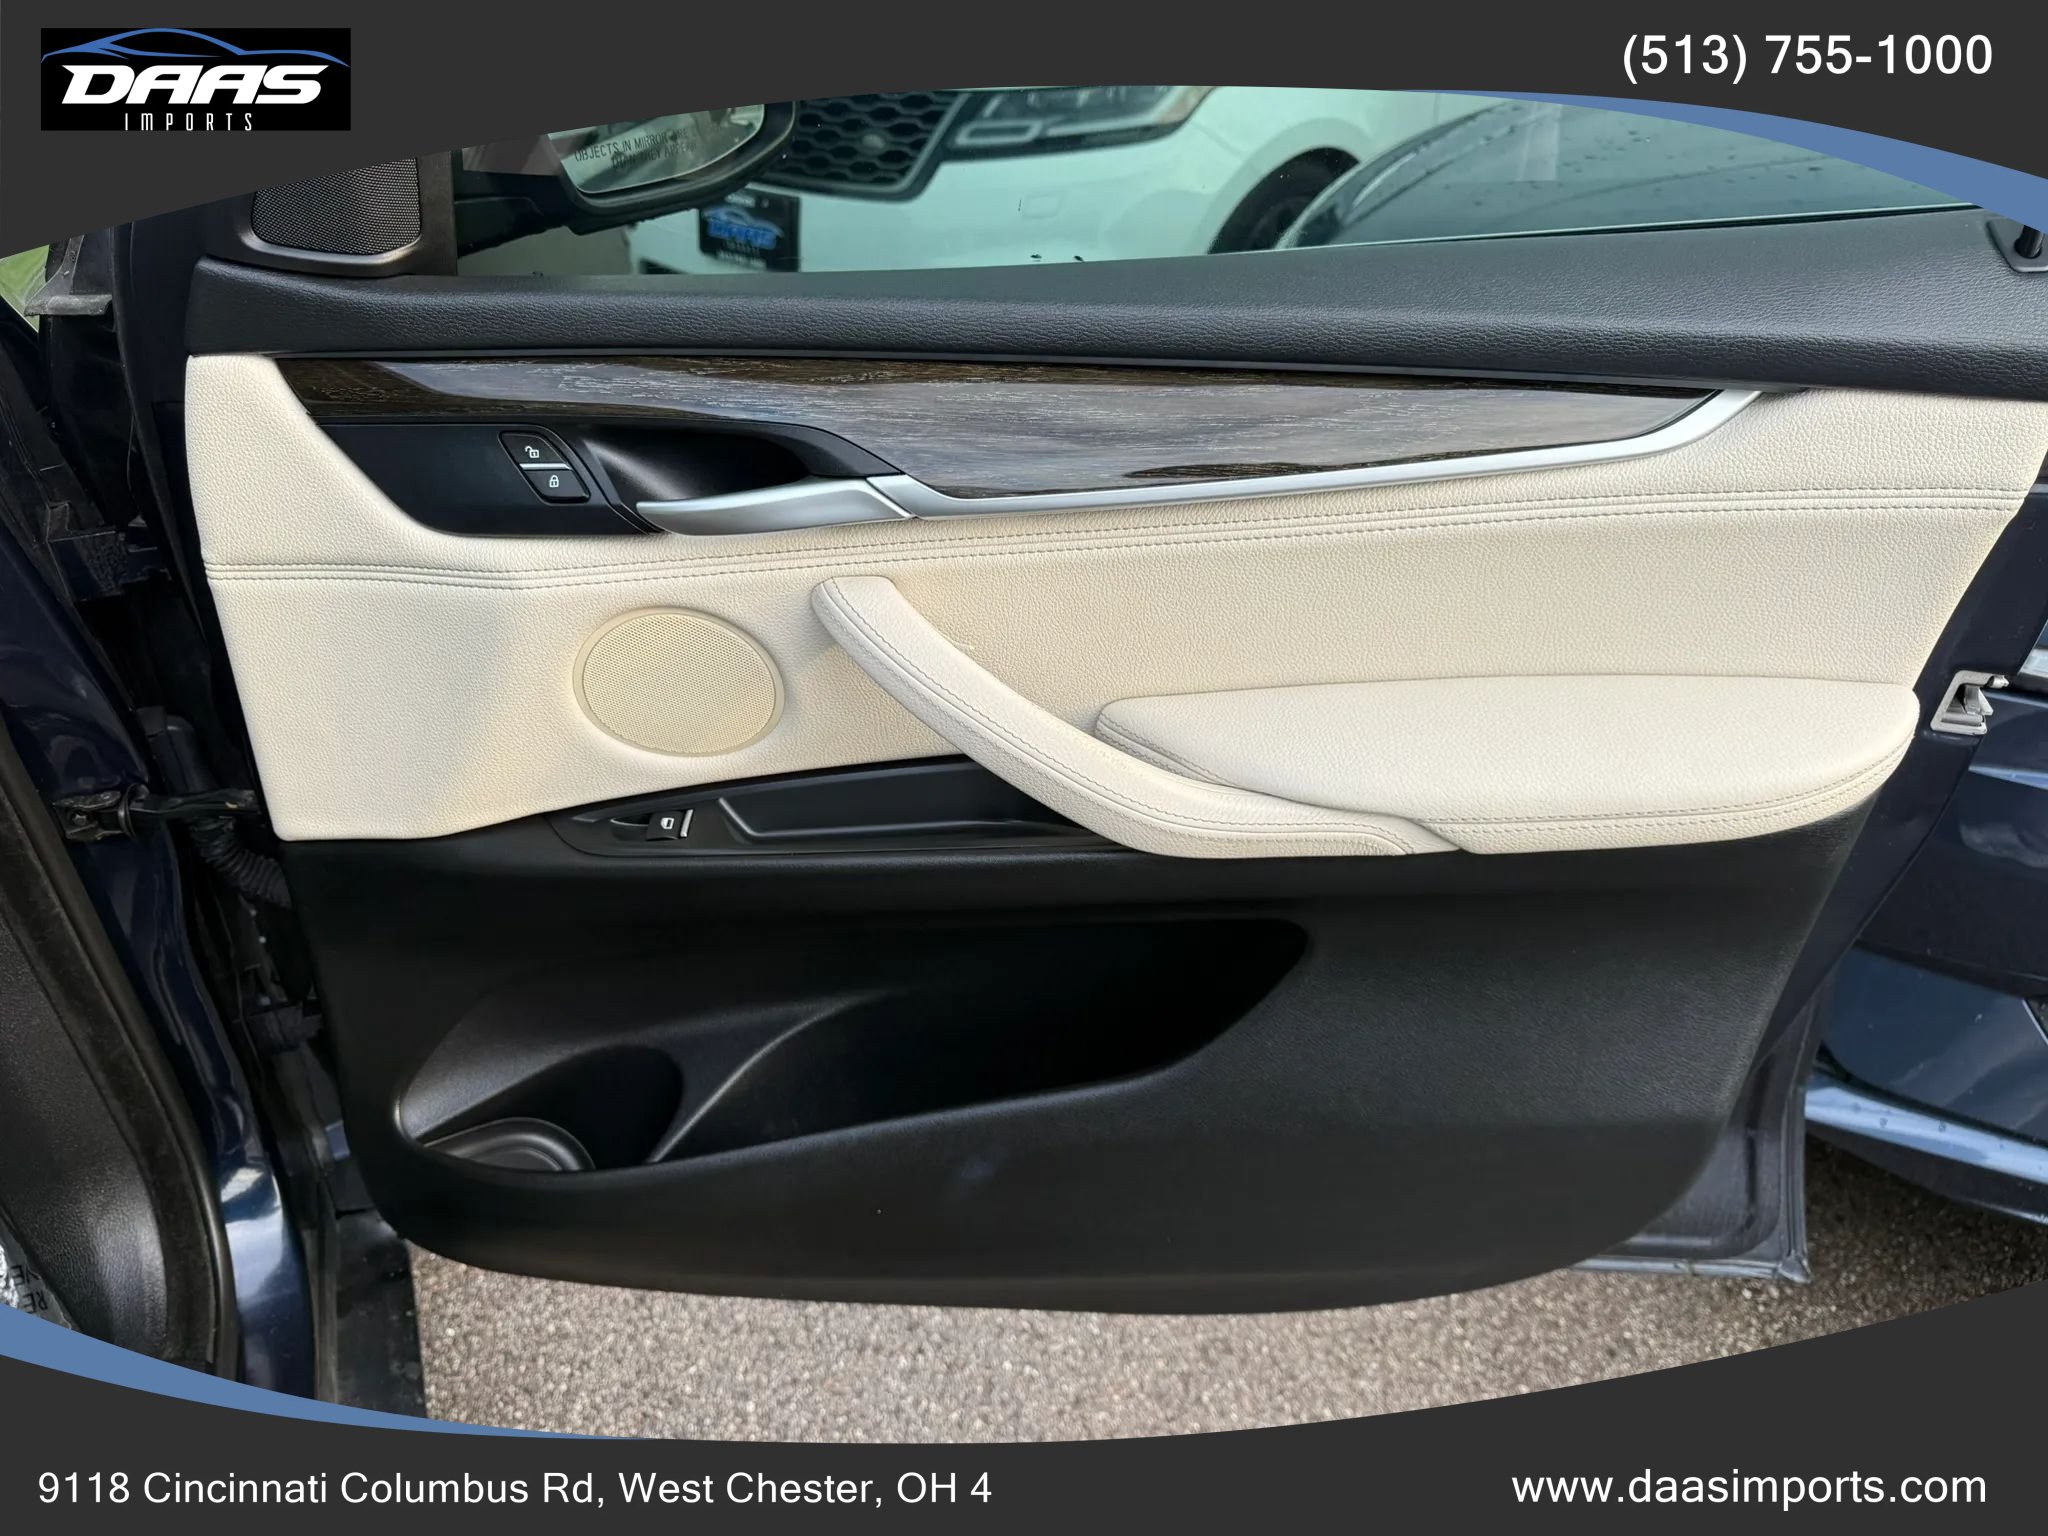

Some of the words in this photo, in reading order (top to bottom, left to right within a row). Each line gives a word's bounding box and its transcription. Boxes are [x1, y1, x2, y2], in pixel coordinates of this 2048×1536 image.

[574, 141, 621, 162] OBJECTS
[621, 138, 632, 153] IN
[634, 131, 669, 150] MIRROR
